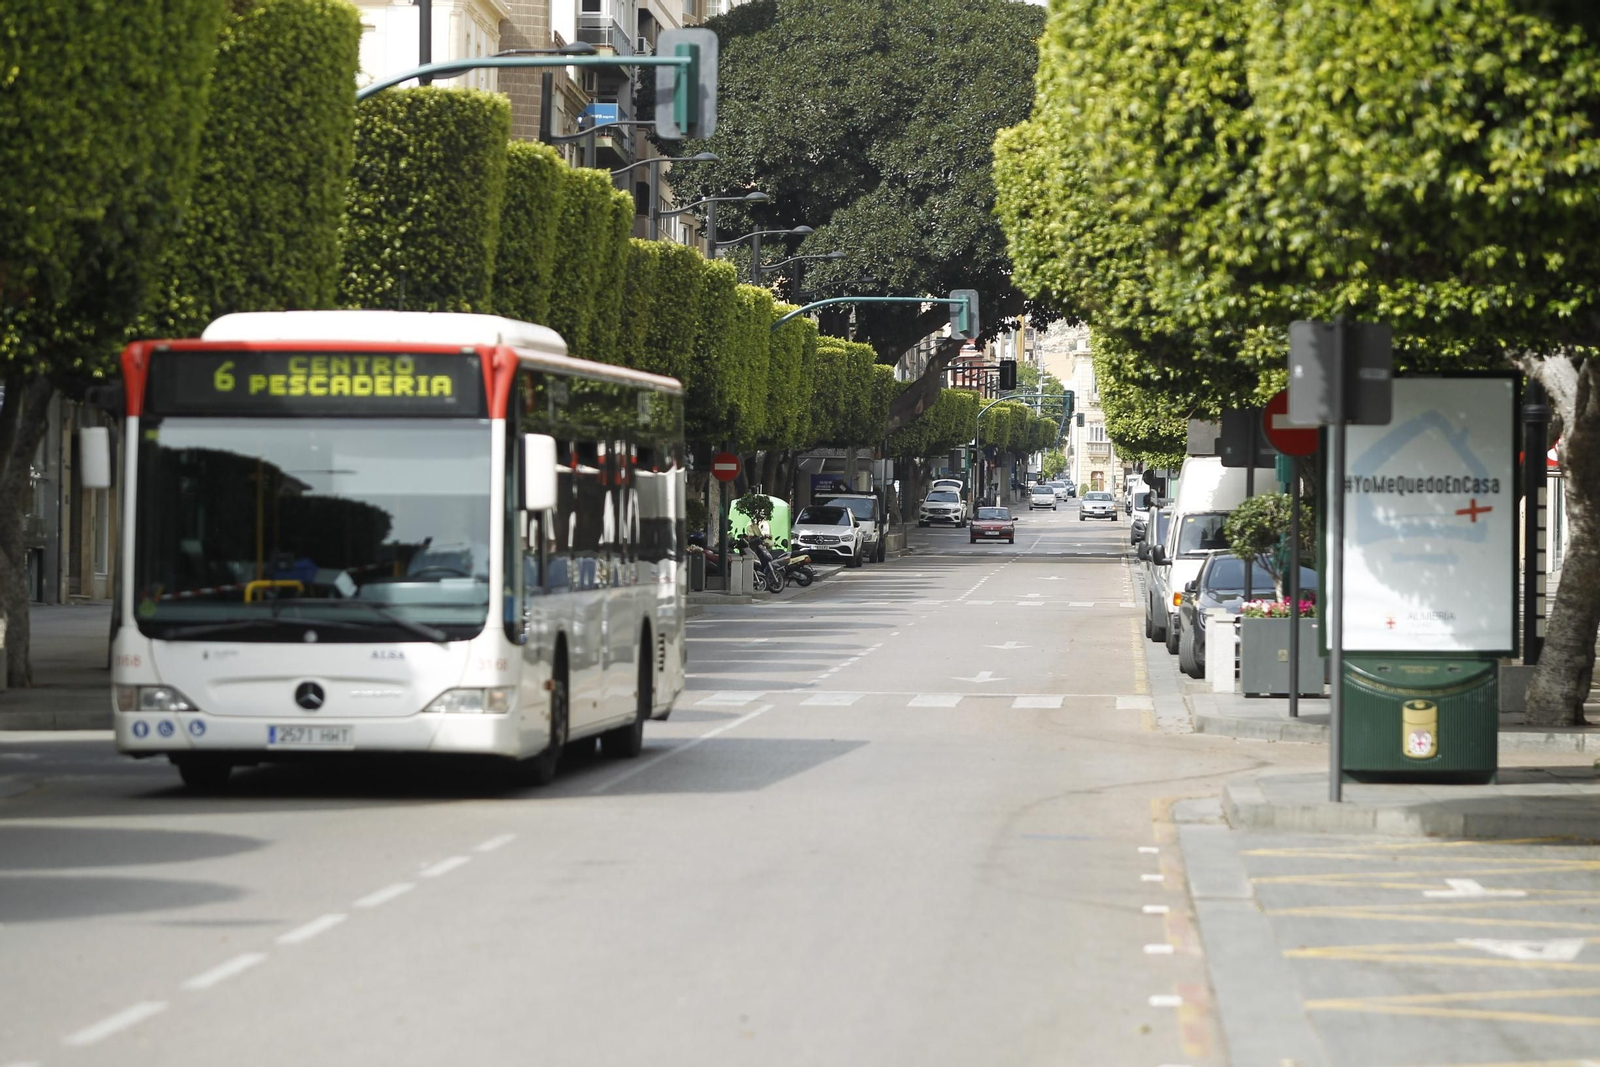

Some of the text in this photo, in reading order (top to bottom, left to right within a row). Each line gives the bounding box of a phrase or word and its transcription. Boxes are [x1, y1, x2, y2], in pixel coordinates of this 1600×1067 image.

[213, 360, 236, 391] 6
[288, 356, 415, 375] CENTRO
[249, 374, 452, 396] PESCADERIA
[1344, 474, 1501, 496] #YoMeQuedoEnCasa
